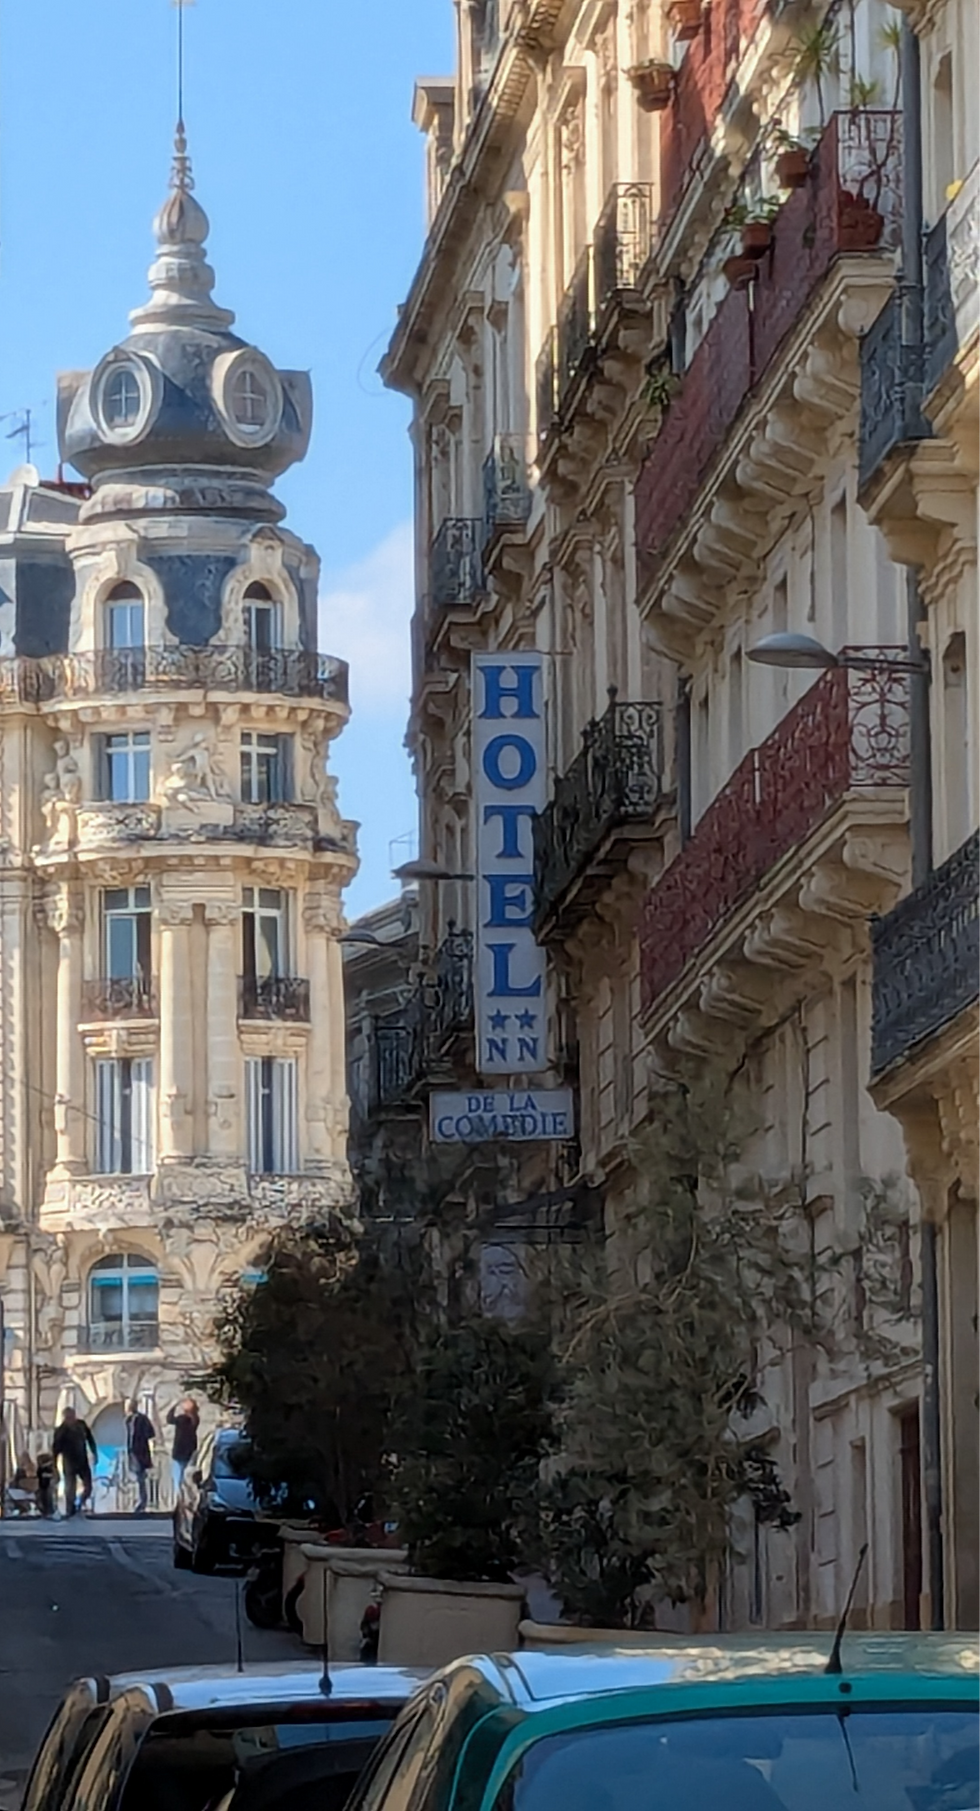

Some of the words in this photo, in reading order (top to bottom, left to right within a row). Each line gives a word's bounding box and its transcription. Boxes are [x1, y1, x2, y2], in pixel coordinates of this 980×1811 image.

[477, 665, 542, 998] HOTEL
[467, 1096, 495, 1113] DE
[509, 1093, 537, 1112] LA
